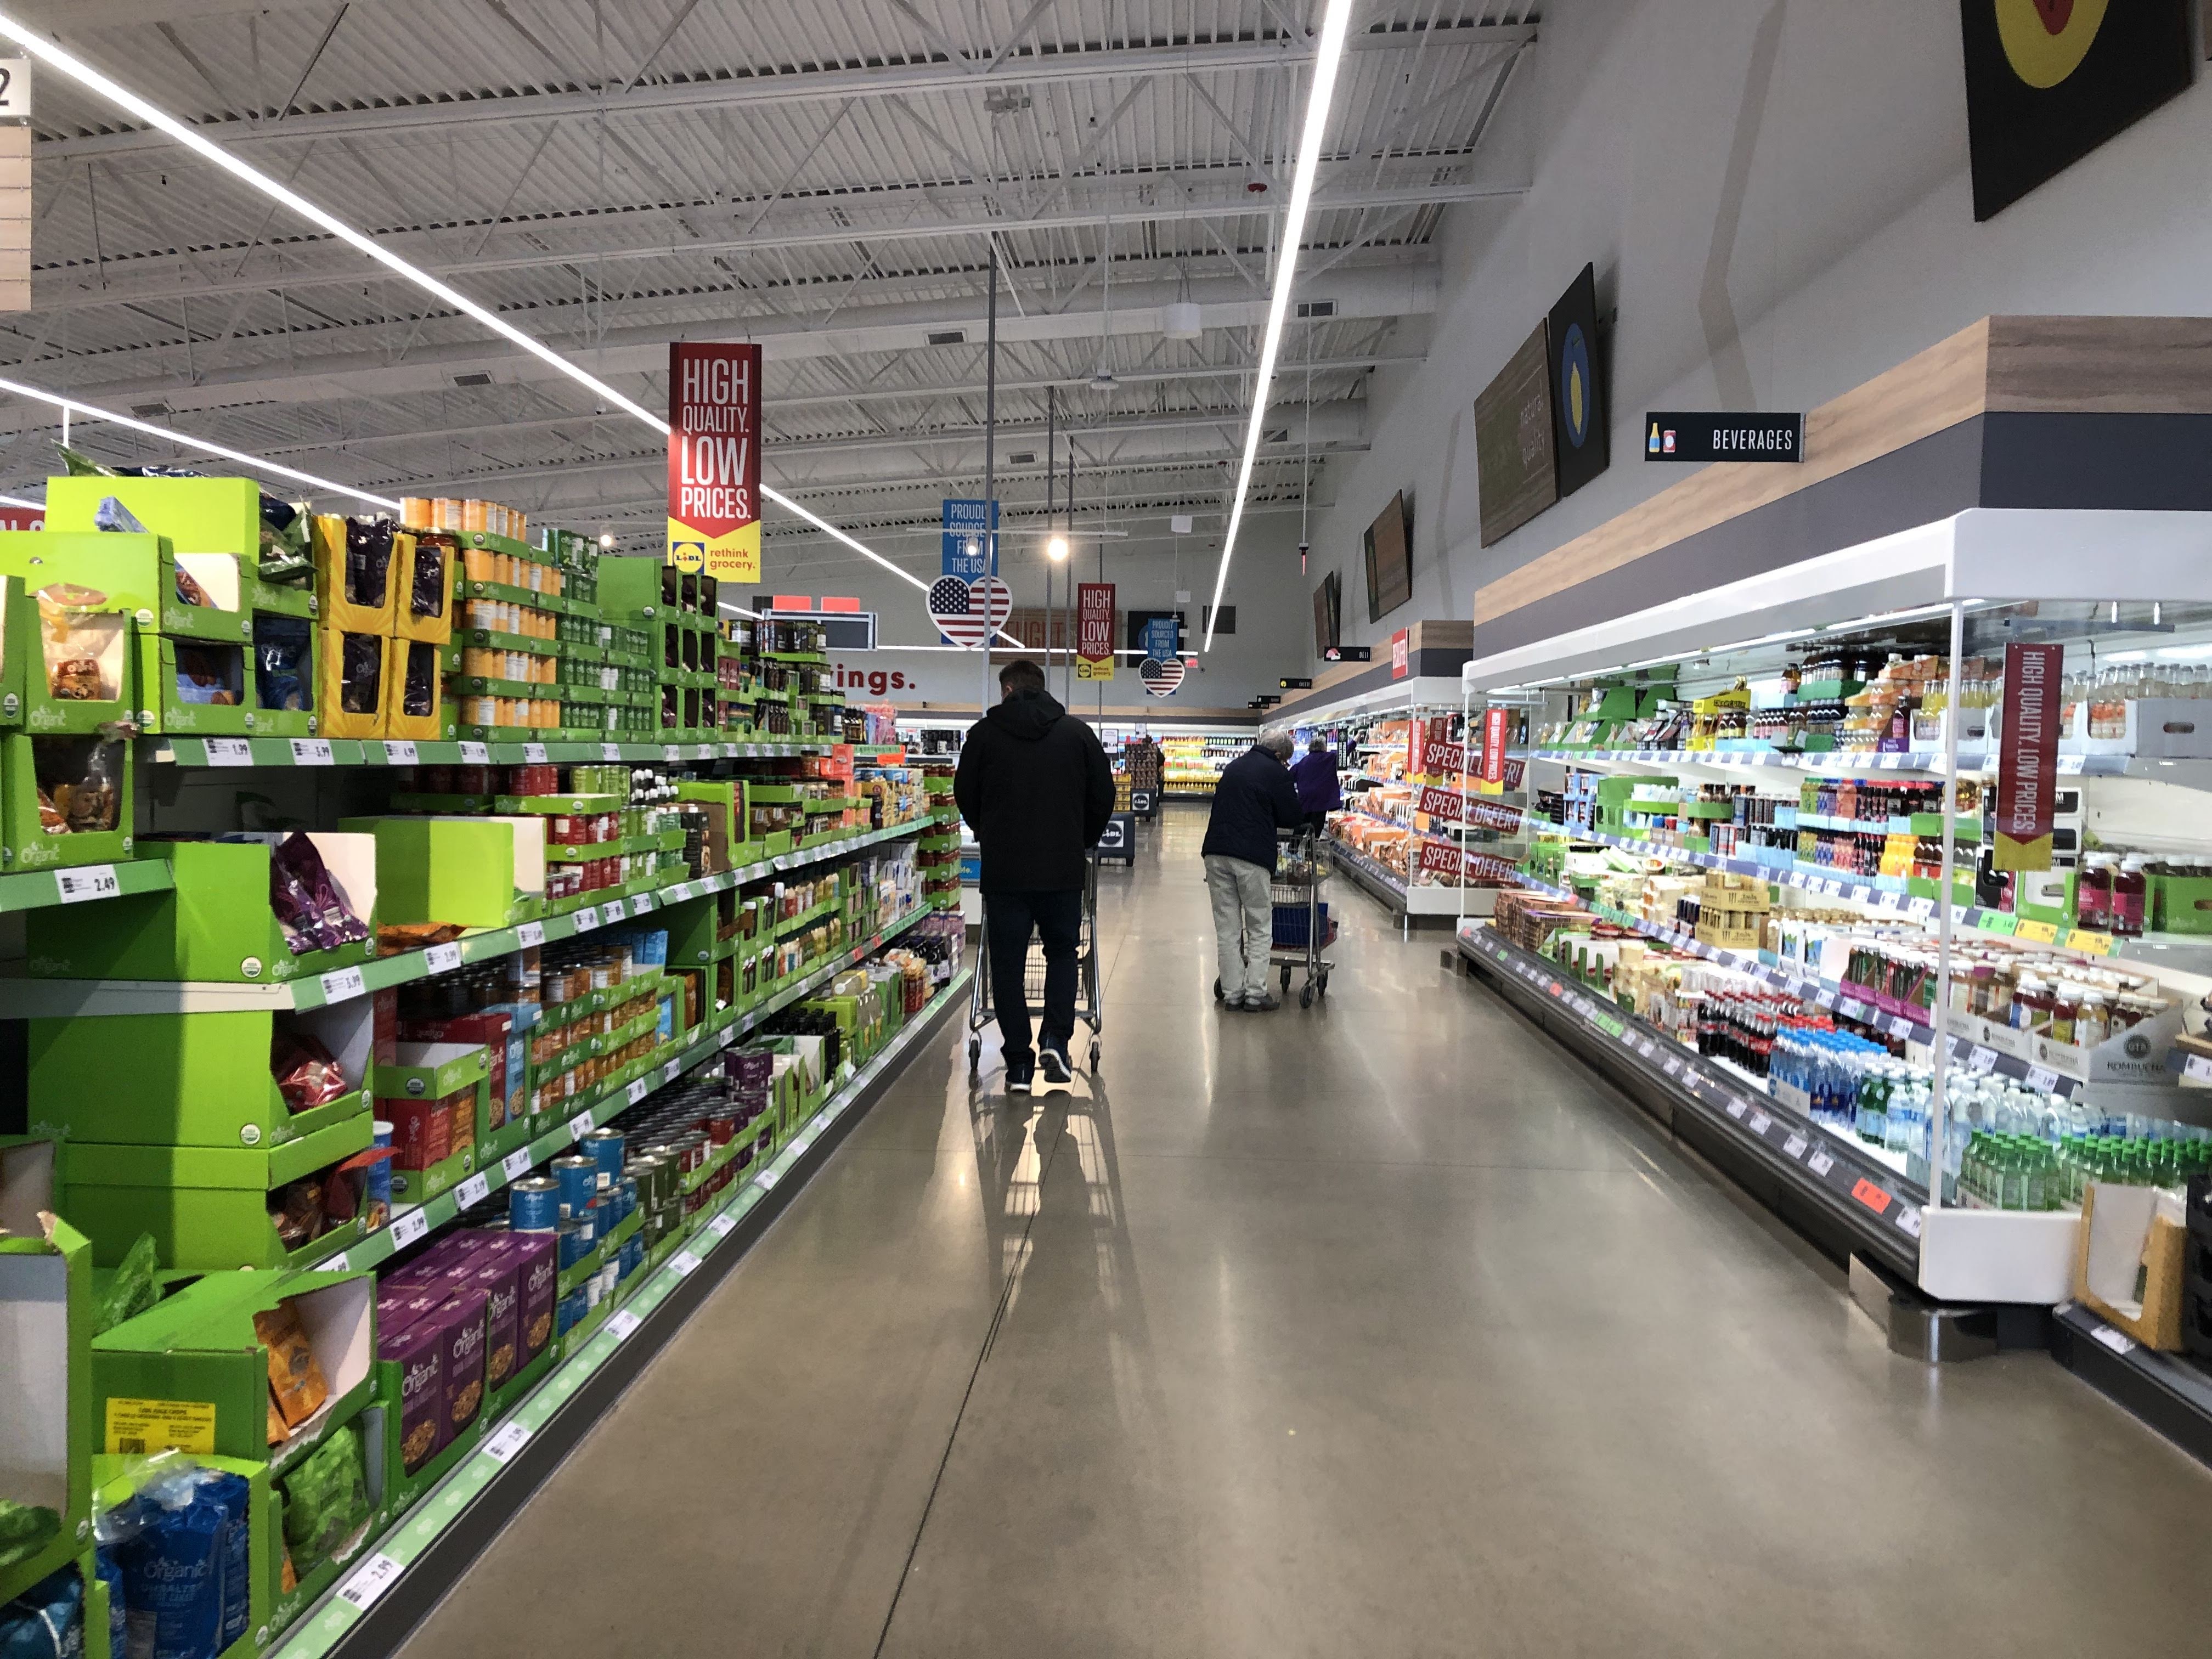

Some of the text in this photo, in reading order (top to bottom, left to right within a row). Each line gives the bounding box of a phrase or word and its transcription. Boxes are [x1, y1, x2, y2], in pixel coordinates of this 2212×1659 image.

[683, 358, 748, 404] HIGH
[682, 405, 749, 435] QUALITY.
[1713, 429, 1793, 450] BEVERAGES
[681, 436, 748, 486] LOW
[681, 486, 751, 519] PRICES.
[951, 504, 986, 520] PROUDL
[950, 521, 985, 538] SOURCE
[710, 548, 748, 558] rethink
[957, 540, 983, 555] FRM
[710, 560, 755, 571] grocery.
[952, 557, 968, 573] THE
[1083, 589, 1110, 608] HIGH
[1082, 608, 1110, 620] QUALITY.
[1082, 621, 1109, 642] LOW
[1152, 620, 1173, 629] PROUDLY
[1082, 642, 1111, 655] PRICES.
[1153, 648, 1172, 657] THE USA
[1155, 639, 1170, 648] FROM
[831, 663, 916, 696] ings.
[2012, 651, 2046, 833] HIGH QUALITY. LOW PRICES.
[94, 877, 115, 892] 2.49
[453, 1319, 484, 1359] Organic
[402, 1353, 437, 1397] Organic
[143, 1556, 207, 1582] Organic
